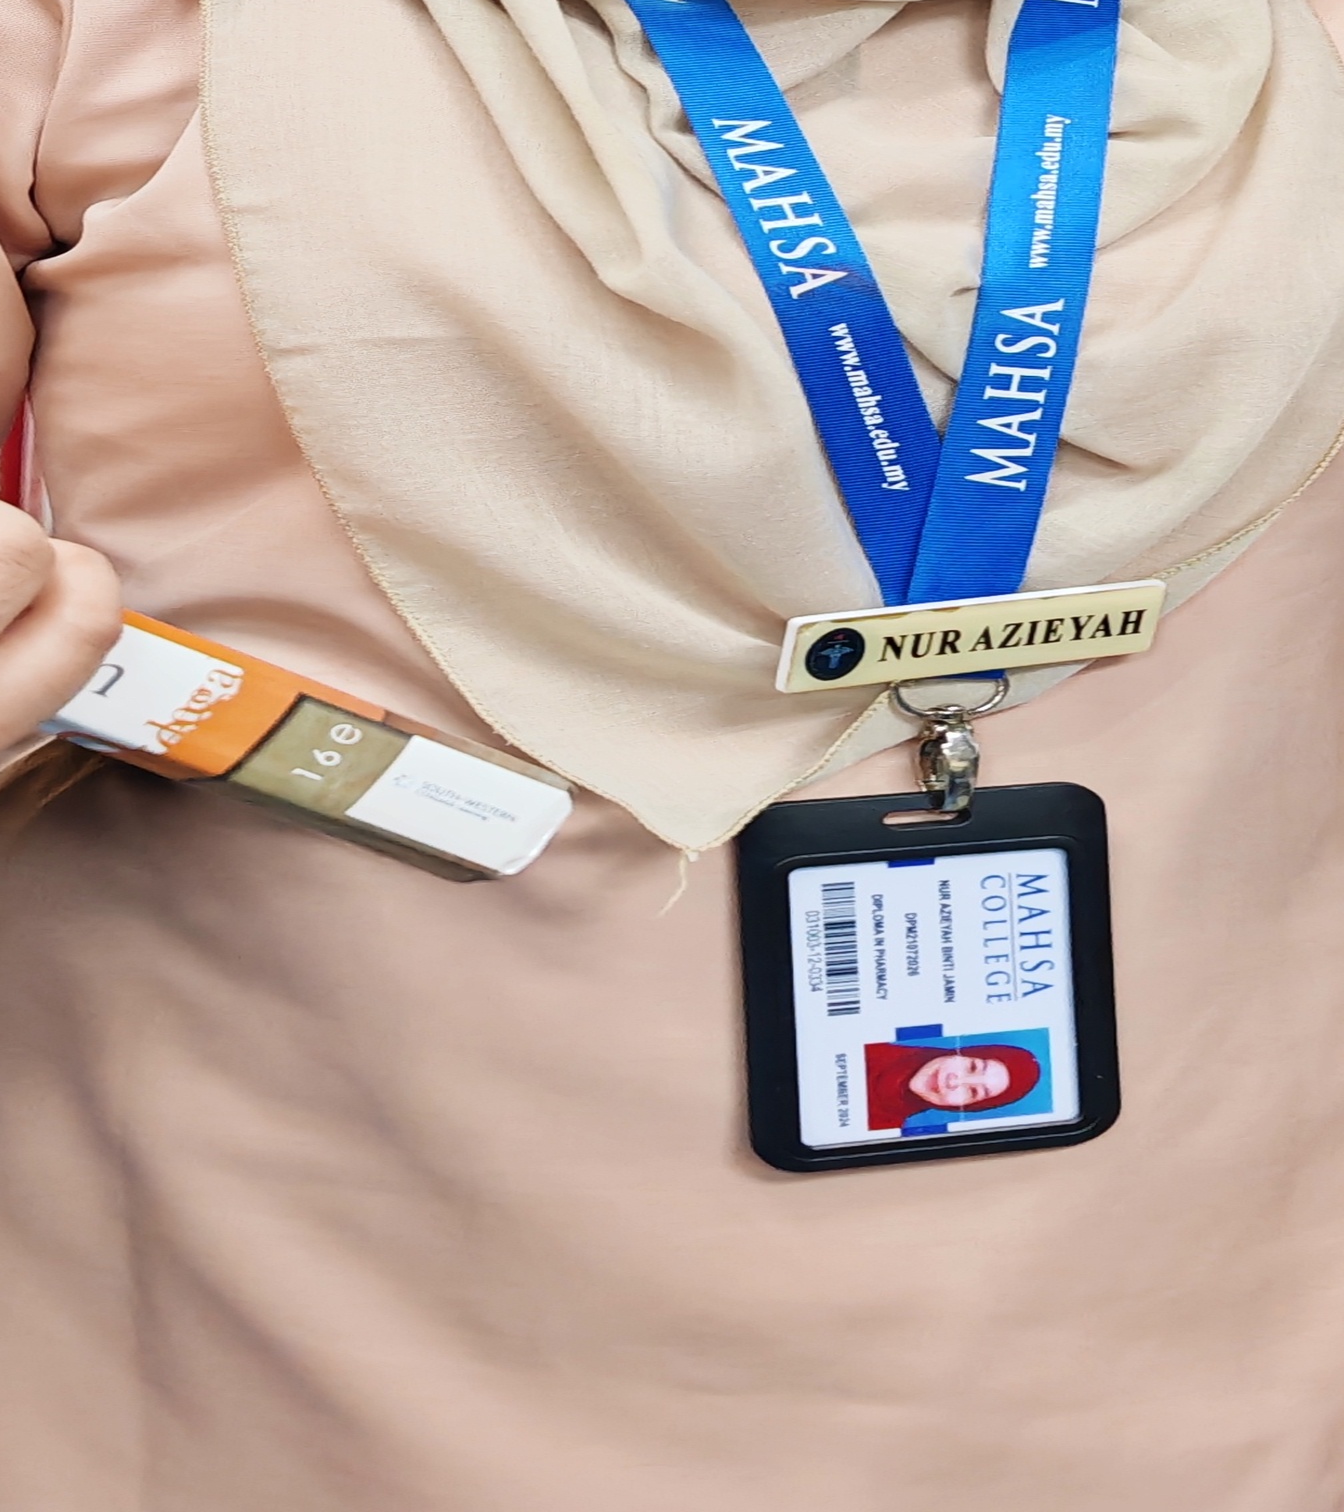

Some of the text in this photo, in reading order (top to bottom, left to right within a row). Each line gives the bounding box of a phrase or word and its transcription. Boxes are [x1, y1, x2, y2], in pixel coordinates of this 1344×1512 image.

[711, 117, 849, 300] MAHSA
[1027, 114, 1072, 270] www.mahsa.edu.my
[827, 321, 911, 492] www.mahsa.edu.my
[963, 297, 1066, 492] MAHSA
[877, 608, 1149, 663] NUR AZIEYAH
[871, 893, 885, 937] DIPLOMA
[937, 879, 951, 901] NUR
[939, 901, 953, 945] AZIEYAH
[979, 873, 1012, 1005] COLLEGE
[1015, 872, 1055, 999] MAHSA
[873, 947, 888, 1001] PHARMACY
[941, 946, 955, 972] BINTI
[834, 1053, 849, 1108] SEPTEMBER
